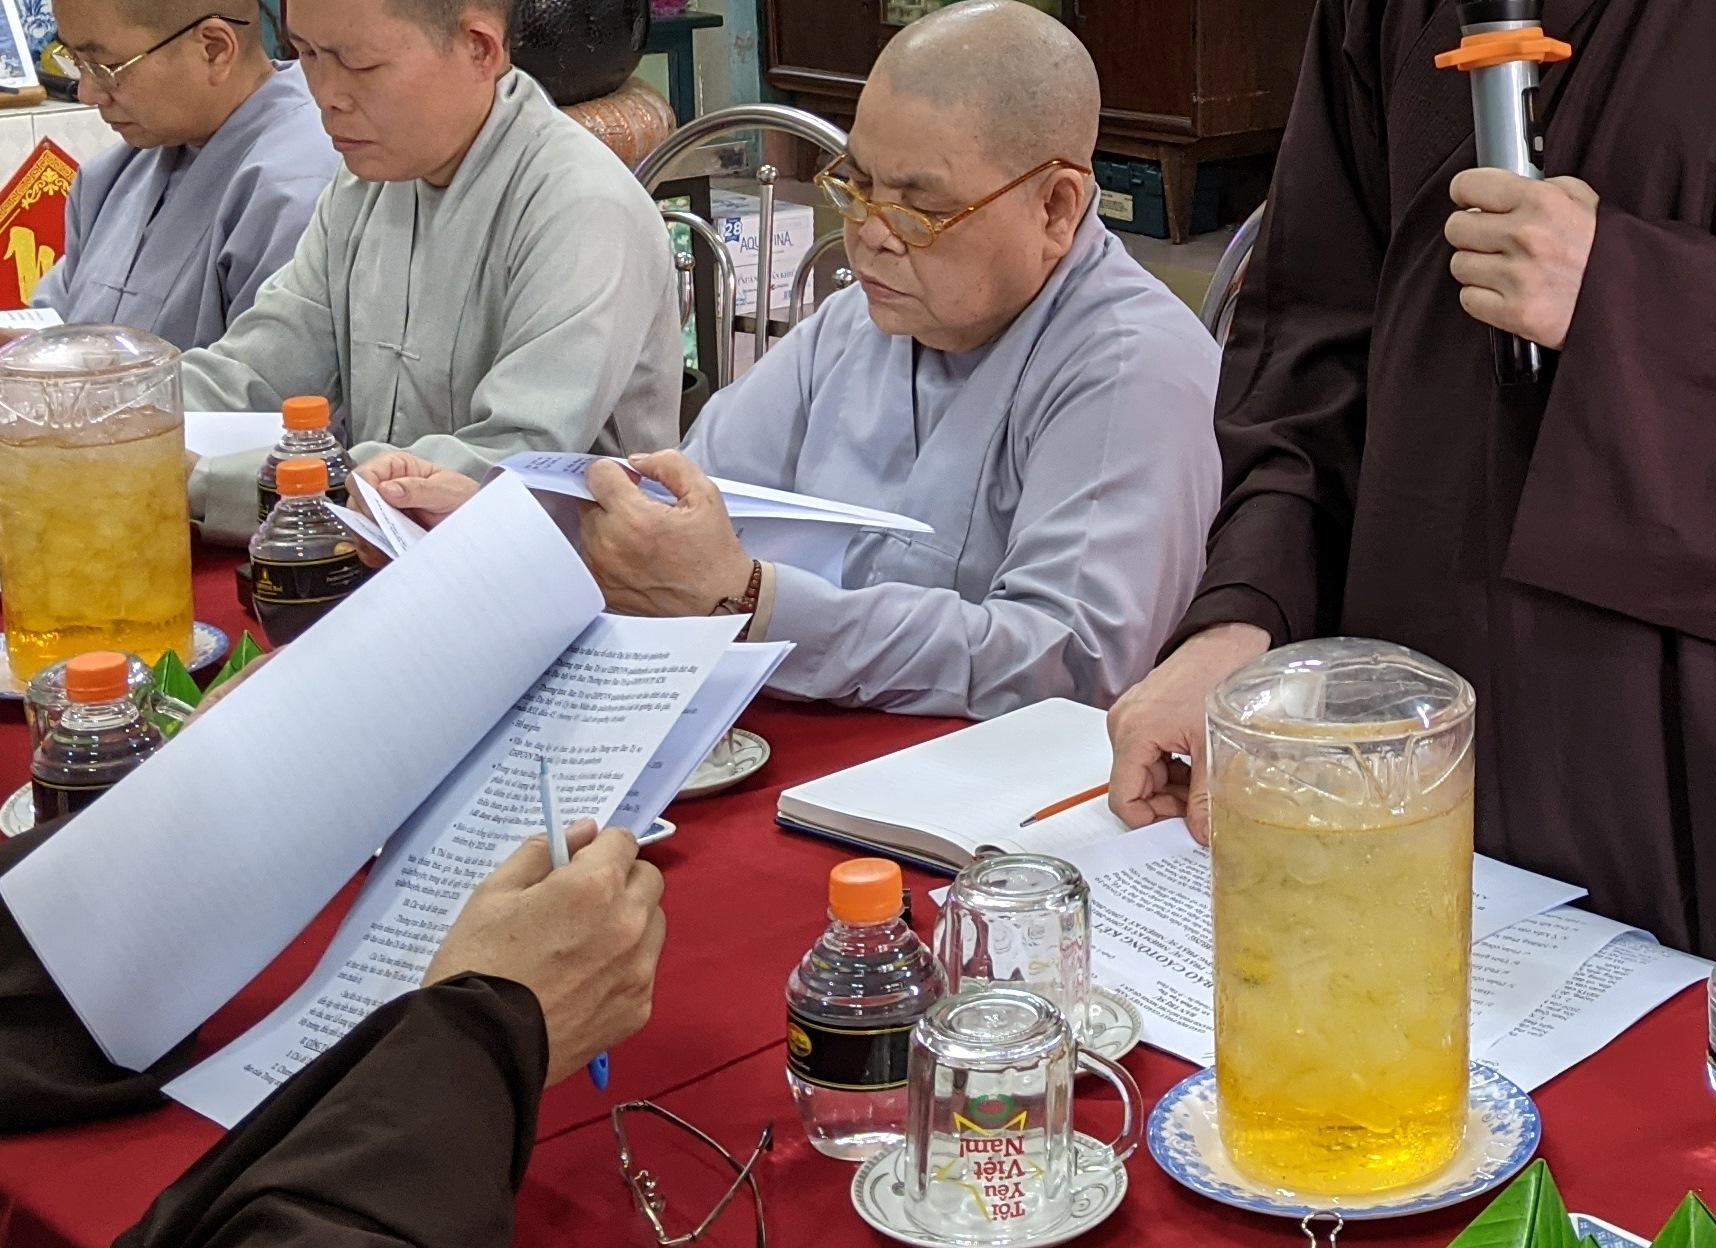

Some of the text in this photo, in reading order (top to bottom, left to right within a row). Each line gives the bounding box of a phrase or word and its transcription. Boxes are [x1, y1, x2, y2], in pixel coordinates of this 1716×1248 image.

[960, 1136, 1025, 1157] Nam!
[974, 1156, 1025, 1182] Việt
[984, 1182, 1025, 1201] Yêu
[992, 1202, 1025, 1221] Tôi
